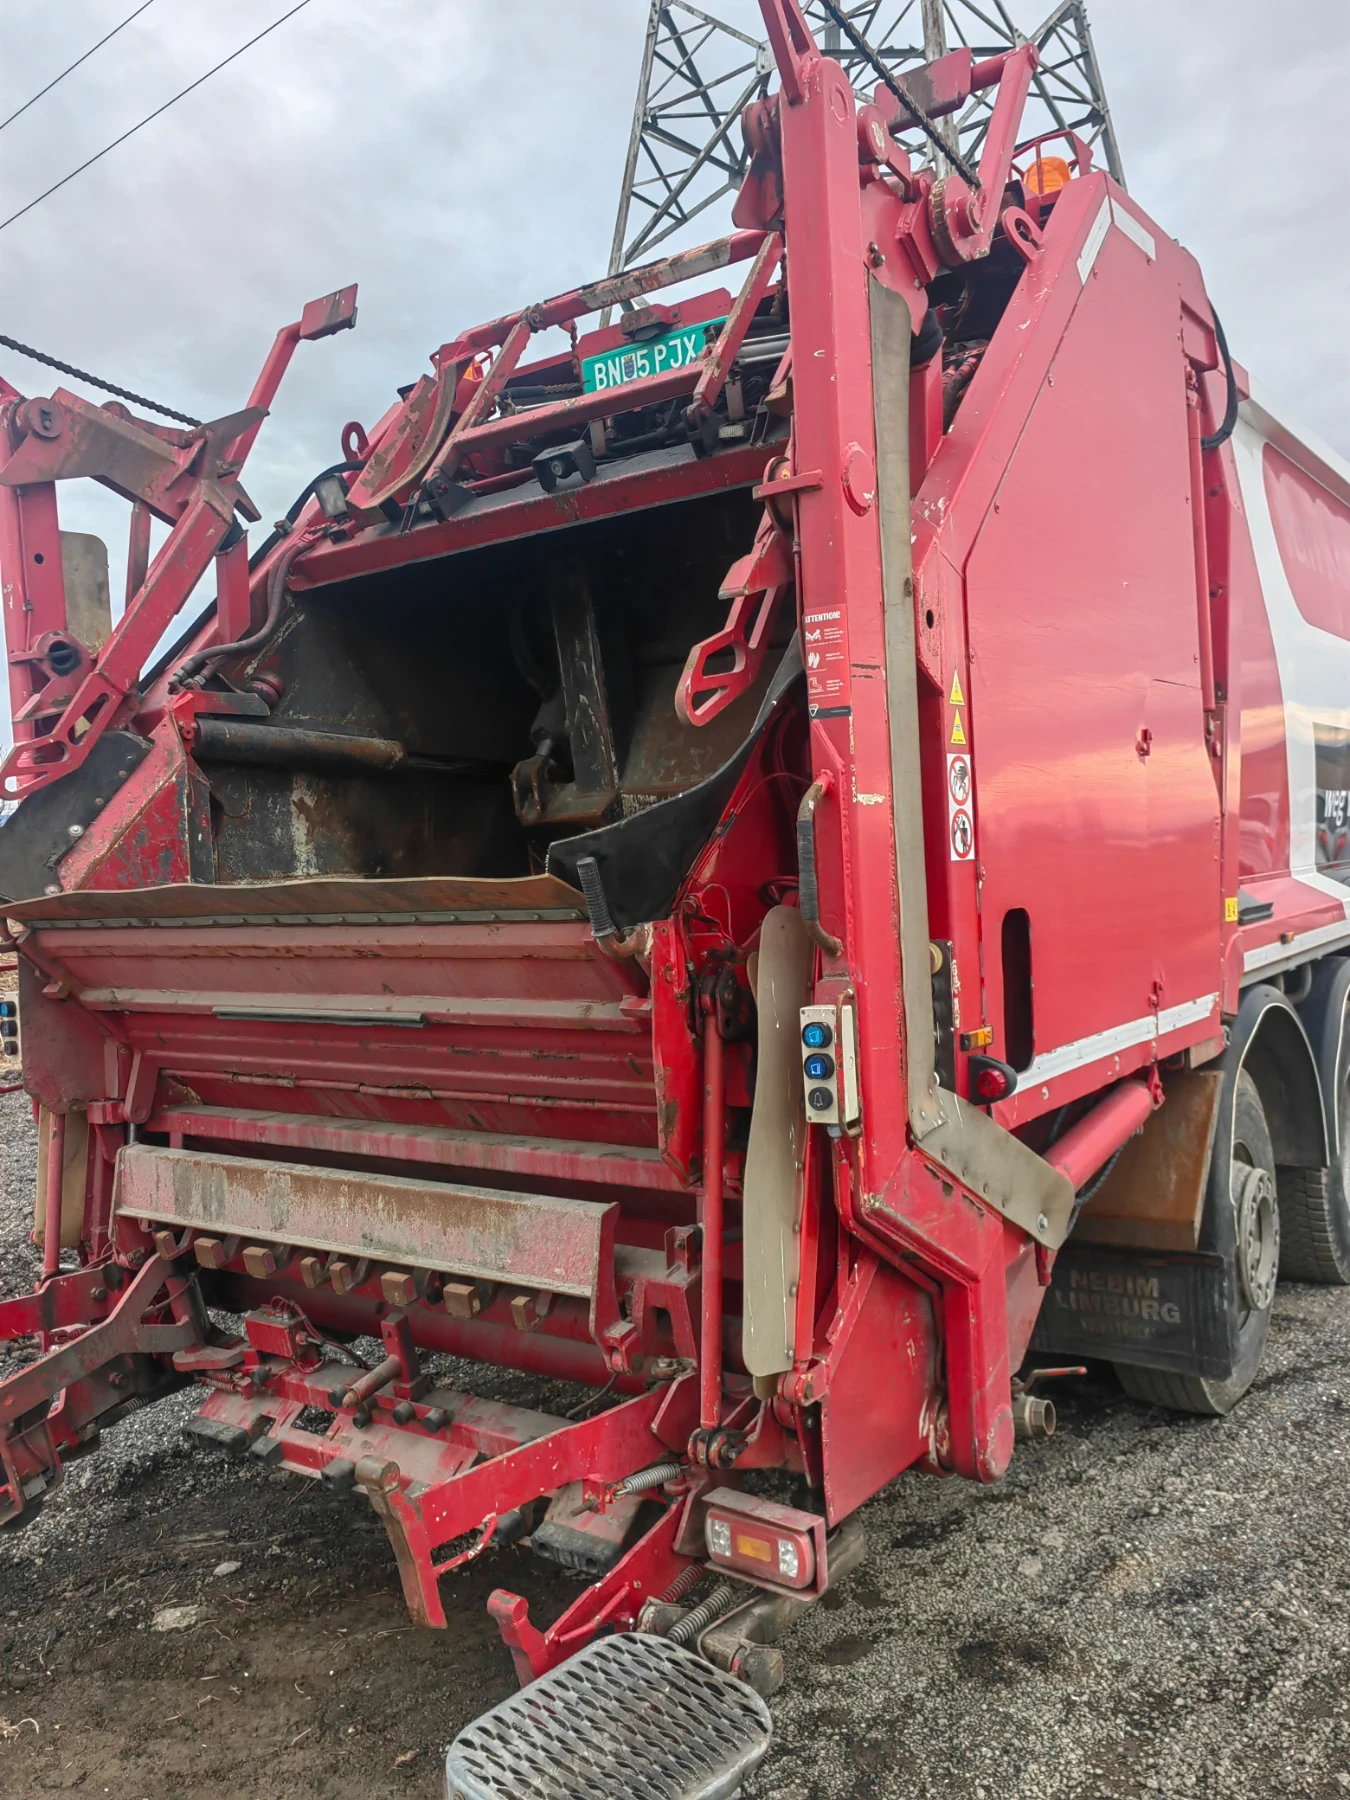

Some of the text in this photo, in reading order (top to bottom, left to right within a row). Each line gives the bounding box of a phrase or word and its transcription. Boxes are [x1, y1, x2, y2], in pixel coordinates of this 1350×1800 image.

[594, 358, 620, 391] BN
[1069, 1269, 1160, 1298] NEBIM
[1054, 1289, 1181, 1324] LIMBURG
